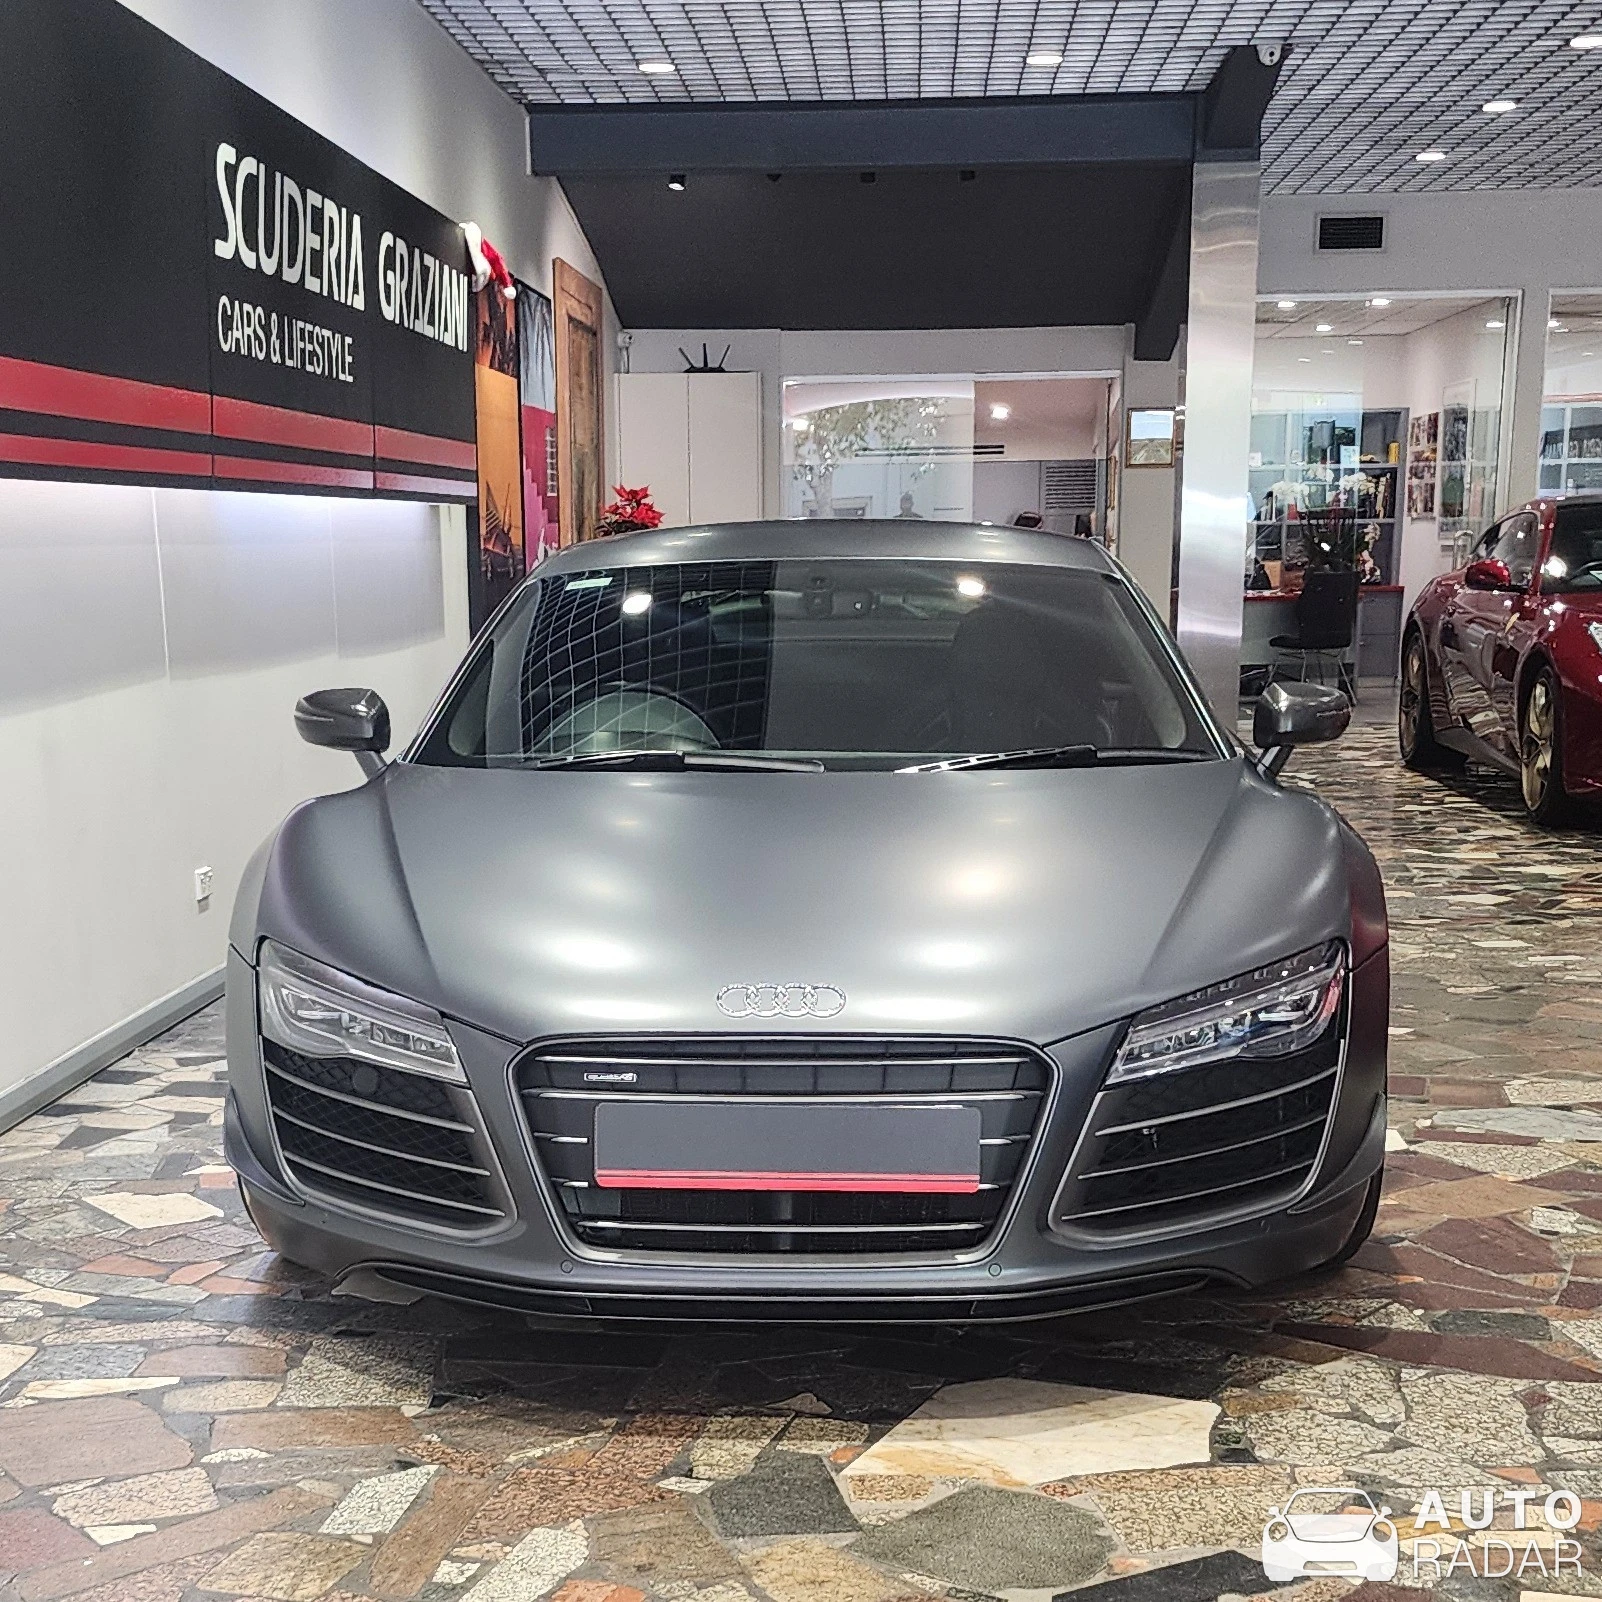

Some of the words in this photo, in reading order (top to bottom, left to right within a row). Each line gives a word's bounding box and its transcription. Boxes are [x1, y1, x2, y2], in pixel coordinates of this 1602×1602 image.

[215, 143, 365, 311] SCUDERIA
[379, 231, 468, 352] GRAZIANI
[218, 295, 266, 361] CARS
[270, 312, 281, 364] &
[284, 315, 354, 382] LIFESTYLE
